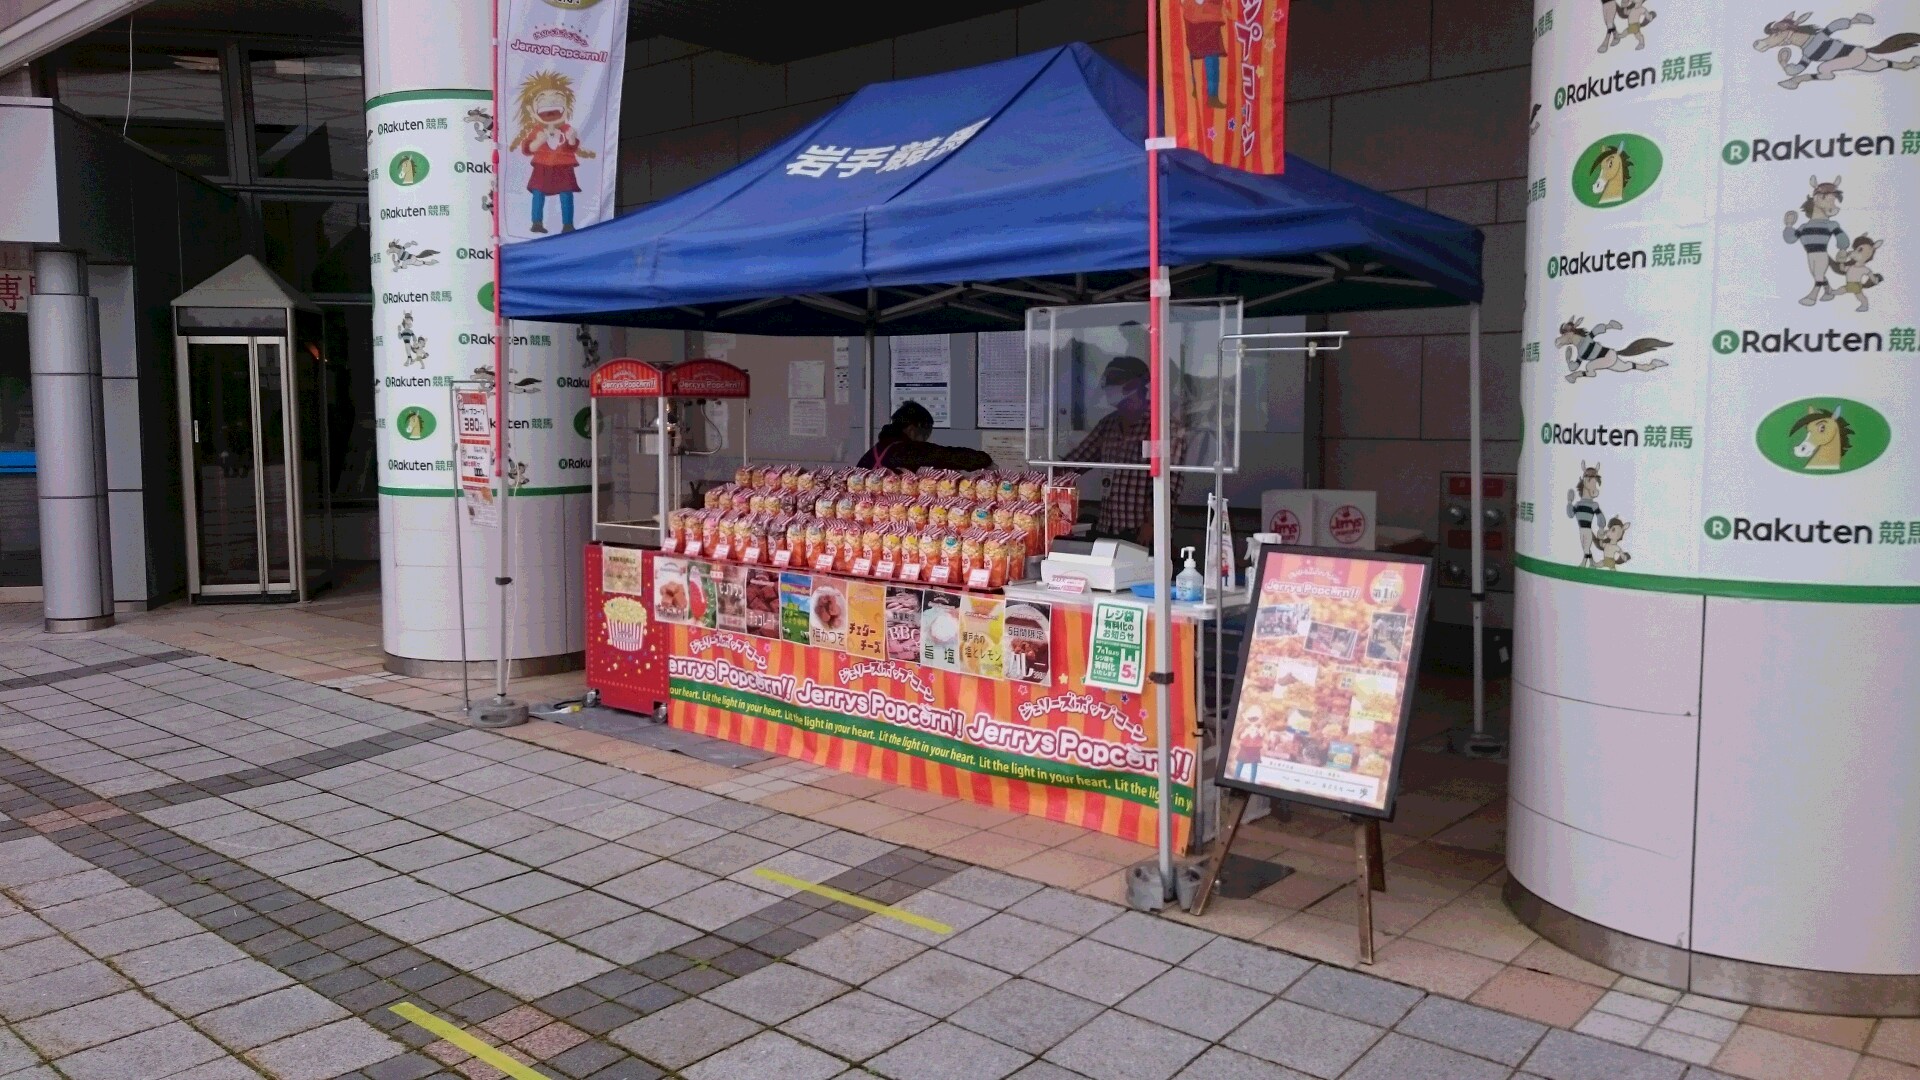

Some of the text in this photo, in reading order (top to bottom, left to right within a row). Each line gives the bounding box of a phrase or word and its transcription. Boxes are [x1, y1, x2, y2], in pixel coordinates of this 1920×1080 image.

[511, 39, 551, 56] Jerrys
[1566, 67, 1656, 106] Rakuten
[1661, 52, 1712, 83] 競馬
[383, 118, 447, 134] Rakuten 競馬
[1752, 133, 1895, 162] Rakuten
[386, 205, 450, 220] Rakuten 競馬
[1559, 249, 1647, 277] Rakuten
[1651, 241, 1702, 267] 競馬
[388, 291, 452, 303] Rakuten 競馬
[530, 335, 551, 346] 競馬
[1741, 328, 1883, 353] Rakuten
[1889, 327, 1920, 353] 競
[391, 376, 431, 387] Rakuten
[566, 377, 590, 388] Raku
[531, 418, 553, 429] 競馬
[1553, 422, 1639, 447] Rakuten
[1643, 425, 1693, 448] 競馬
[393, 460, 433, 471] Rakuten
[568, 459, 592, 470] Raku
[1733, 518, 1873, 544] Rakuten
[1105, 608, 1135, 623] レジ袋
[860, 639, 881, 654] チーズ
[1102, 630, 1135, 642] お知らせ
[690, 632, 768, 669] ジェリーズポップコーン
[669, 655, 796, 699] errys Popcorn!!
[838, 660, 935, 702] ジェリーズポップコーン
[797, 680, 964, 739] Jerrys Popcorn!!
[1018, 692, 1147, 742] ジェリーズポップコーン
[682, 687, 701, 700] heart.
[746, 702, 762, 717] your
[763, 704, 782, 718] heart.
[803, 714, 824, 732] light
[825, 719, 833, 732] in
[834, 723, 851, 739] your
[851, 725, 876, 741] heart.
[879, 730, 889, 742] Lit
[889, 733, 902, 746] the
[902, 736, 921, 754] light
[921, 741, 930, 753] in
[930, 744, 950, 762] your
[950, 748, 976, 766] heart.
[979, 756, 991, 771] Lit
[992, 758, 1009, 774] the
[1011, 762, 1036, 782] light
[1036, 767, 1048, 781] in
[1049, 770, 1075, 791] your
[1076, 774, 1112, 790] heart.
[1115, 778, 1128, 792] Lit
[1129, 781, 1148, 798] the
[967, 712, 1057, 756] Jerrys
